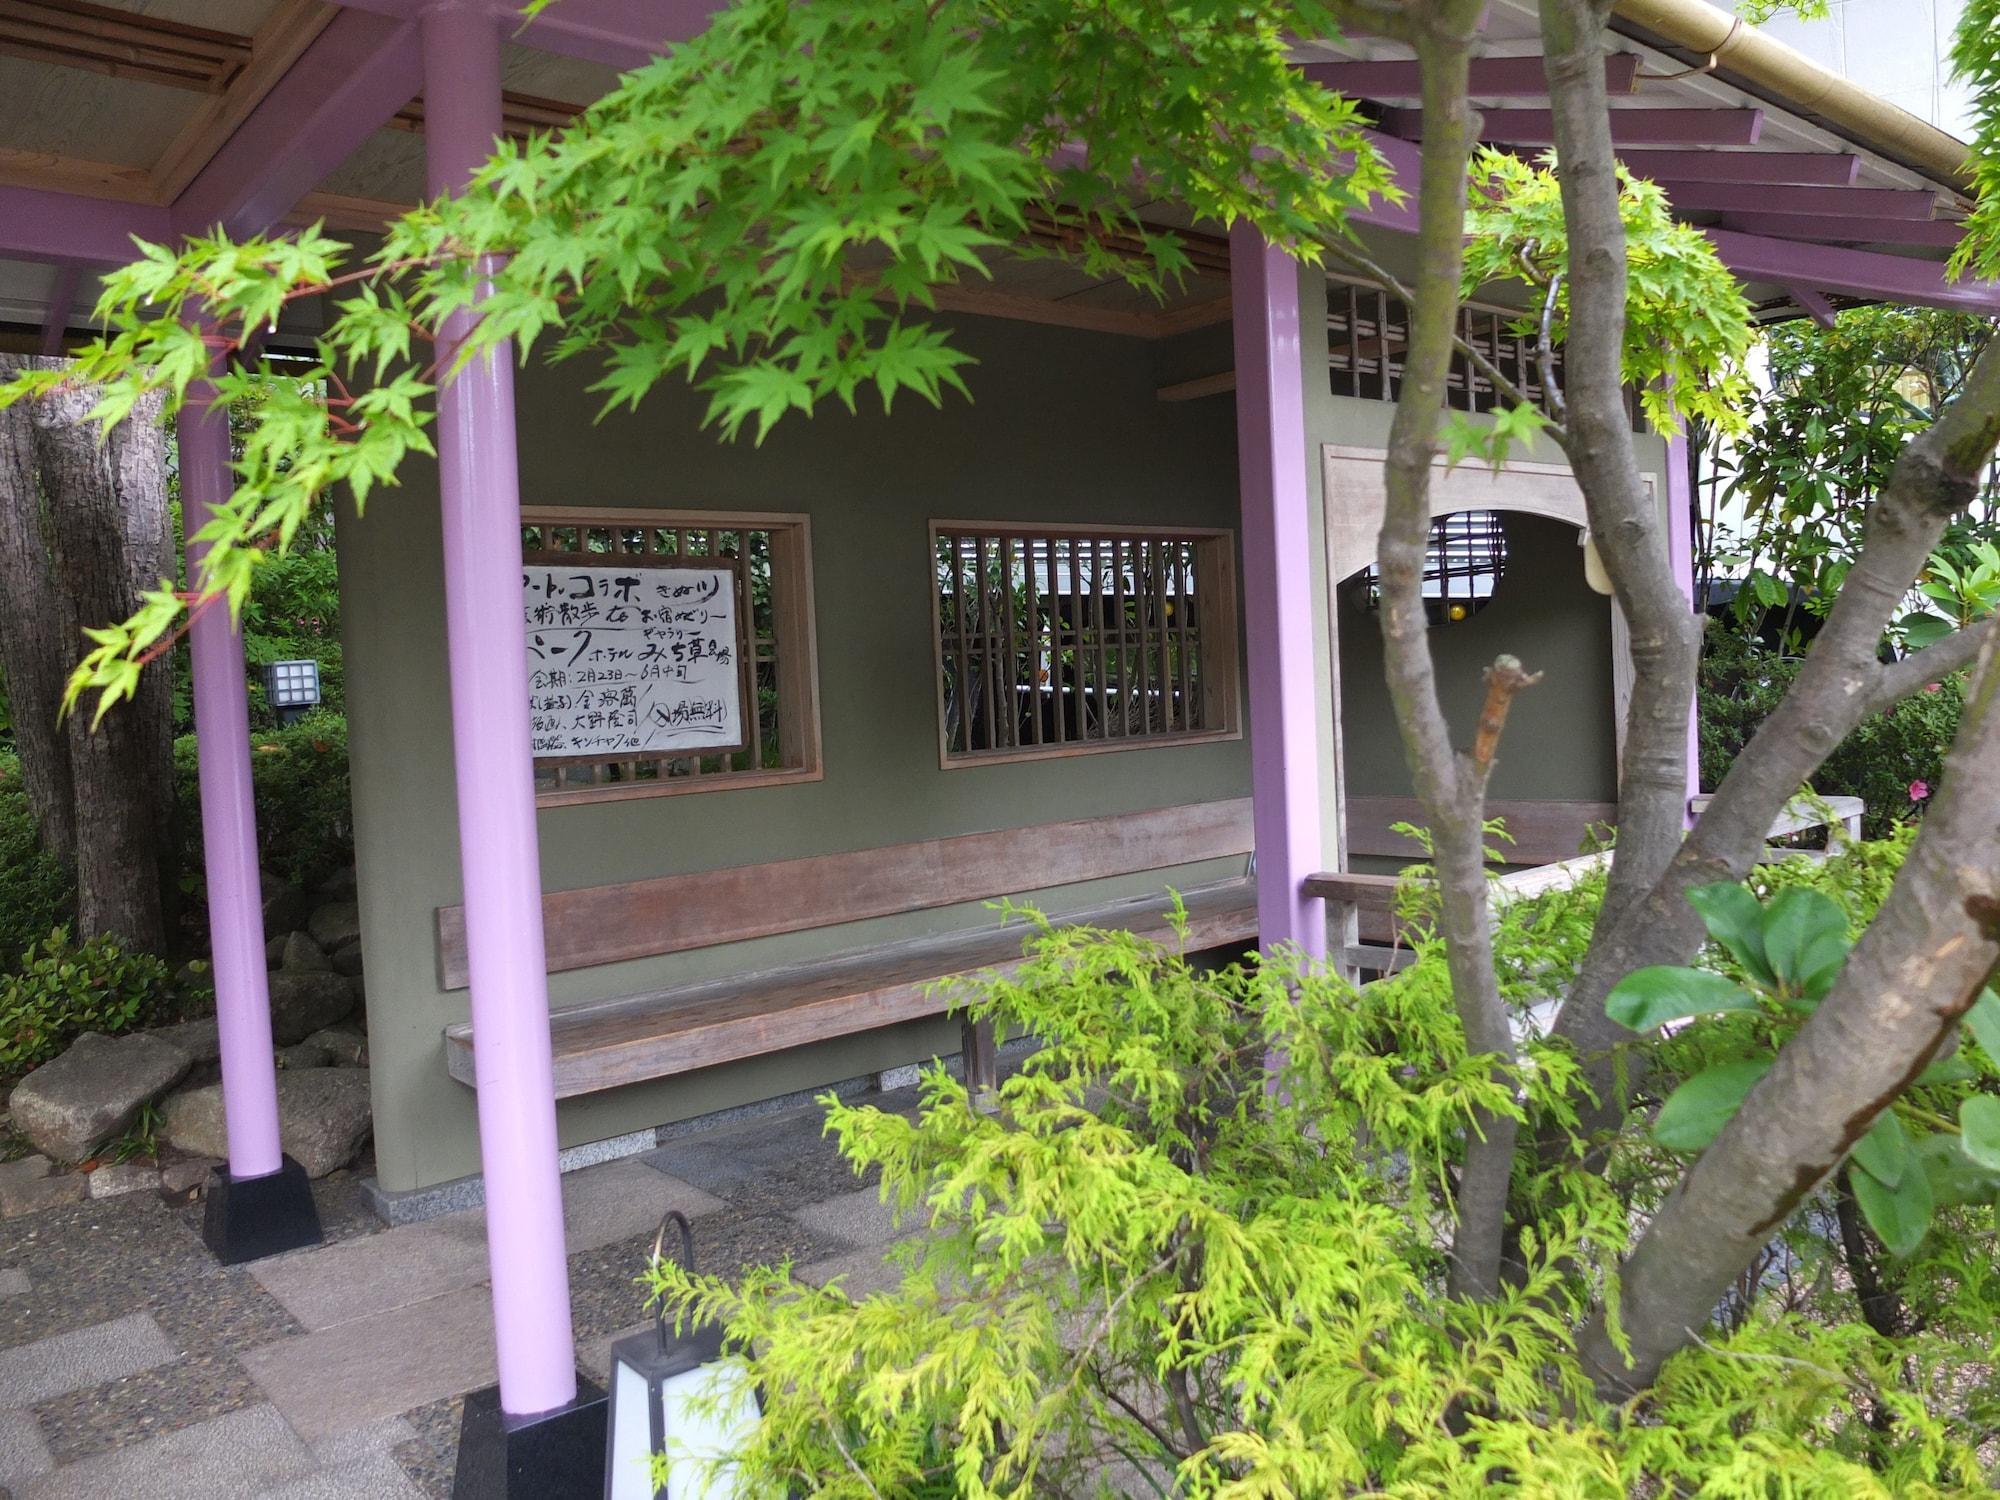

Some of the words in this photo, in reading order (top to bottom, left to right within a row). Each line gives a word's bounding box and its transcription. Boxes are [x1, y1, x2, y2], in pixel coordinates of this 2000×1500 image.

[643, 626, 702, 640] ギャラリー
[655, 699, 723, 727] 入場無料
